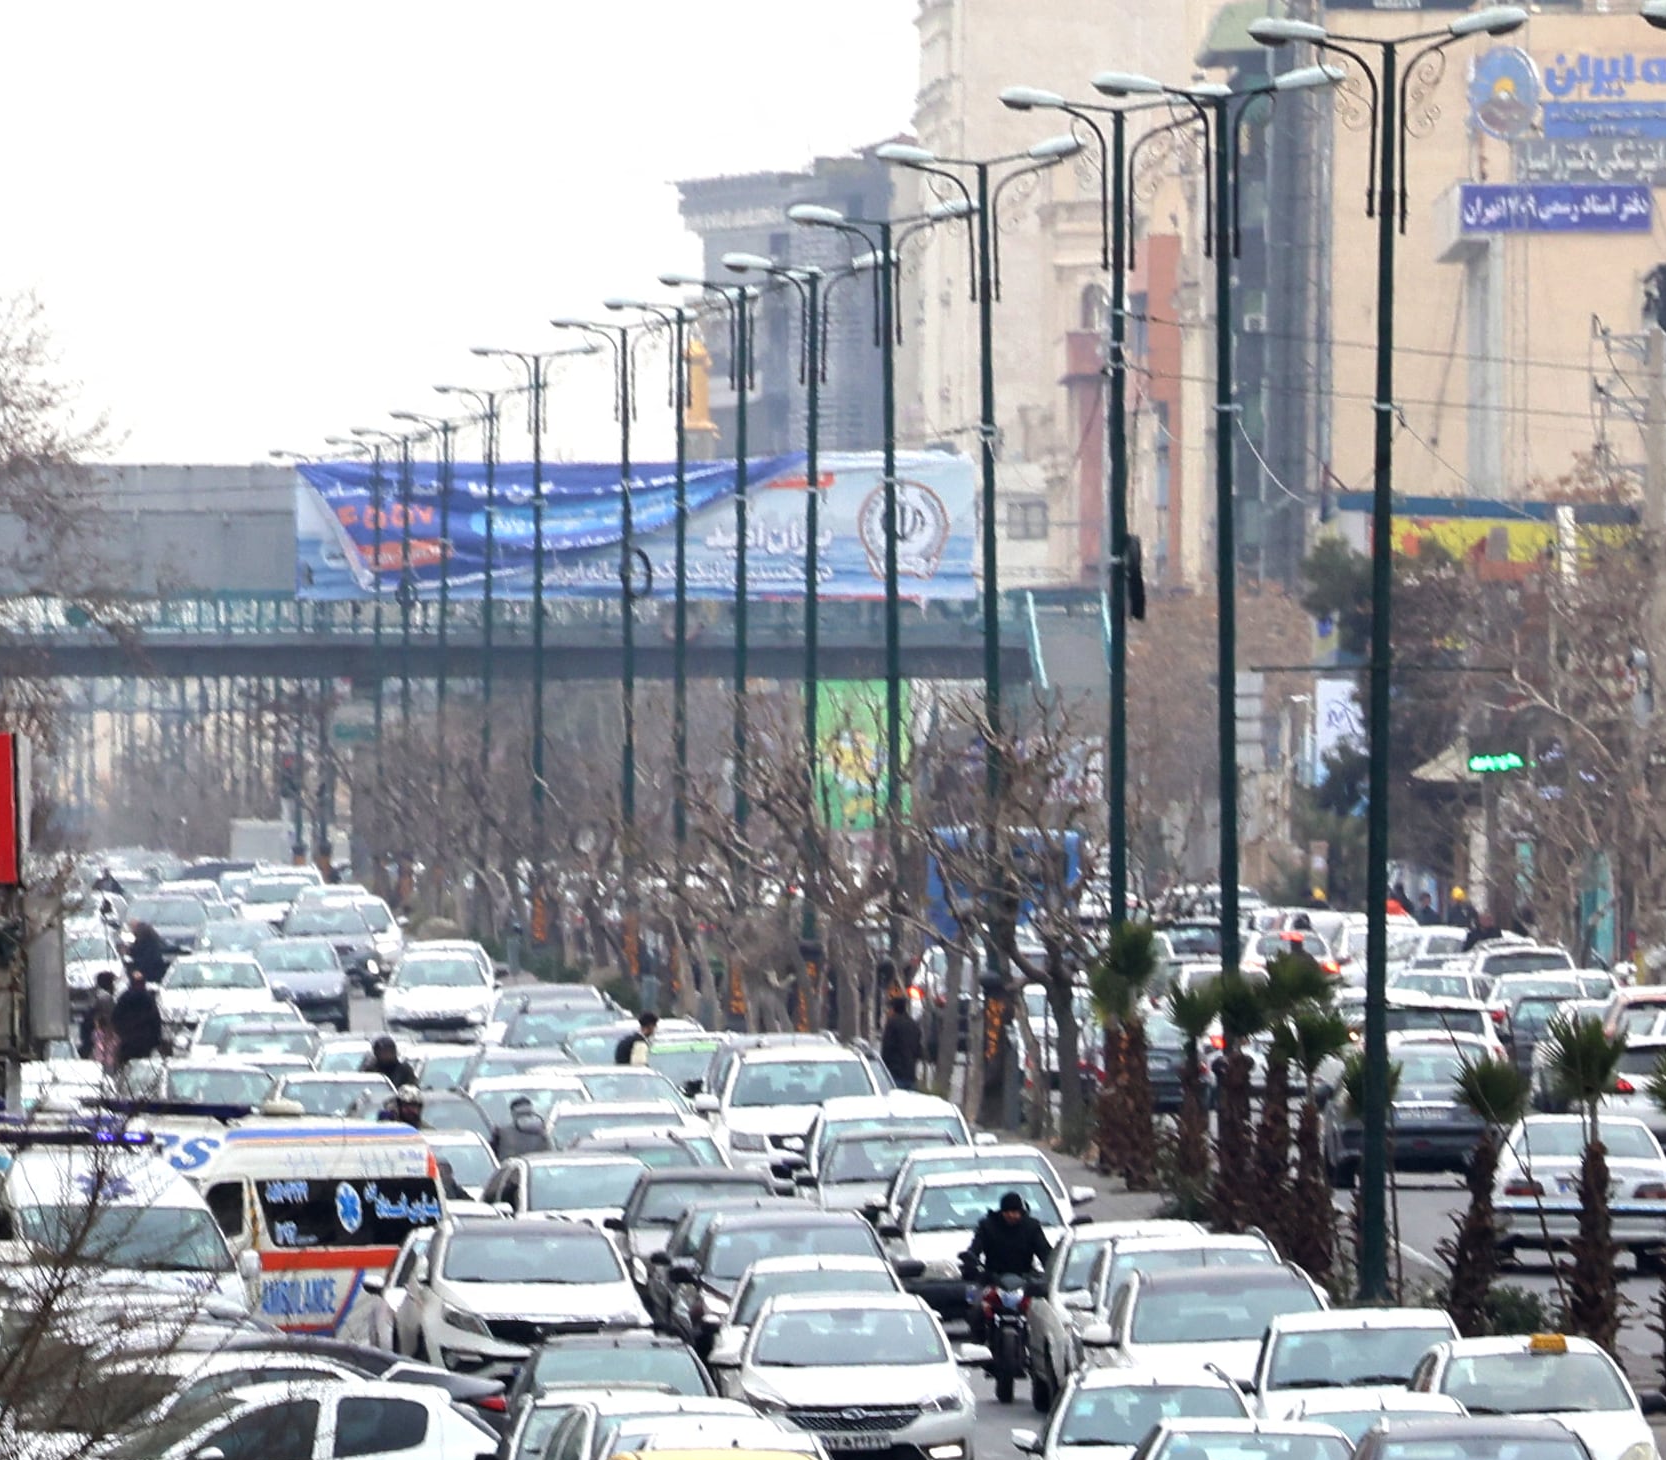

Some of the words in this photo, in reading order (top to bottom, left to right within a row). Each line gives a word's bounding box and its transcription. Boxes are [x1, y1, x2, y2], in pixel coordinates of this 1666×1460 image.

[1545, 53, 1636, 97] ایران
[1538, 197, 1582, 223] رسمی
[1583, 190, 1617, 219] اسناد
